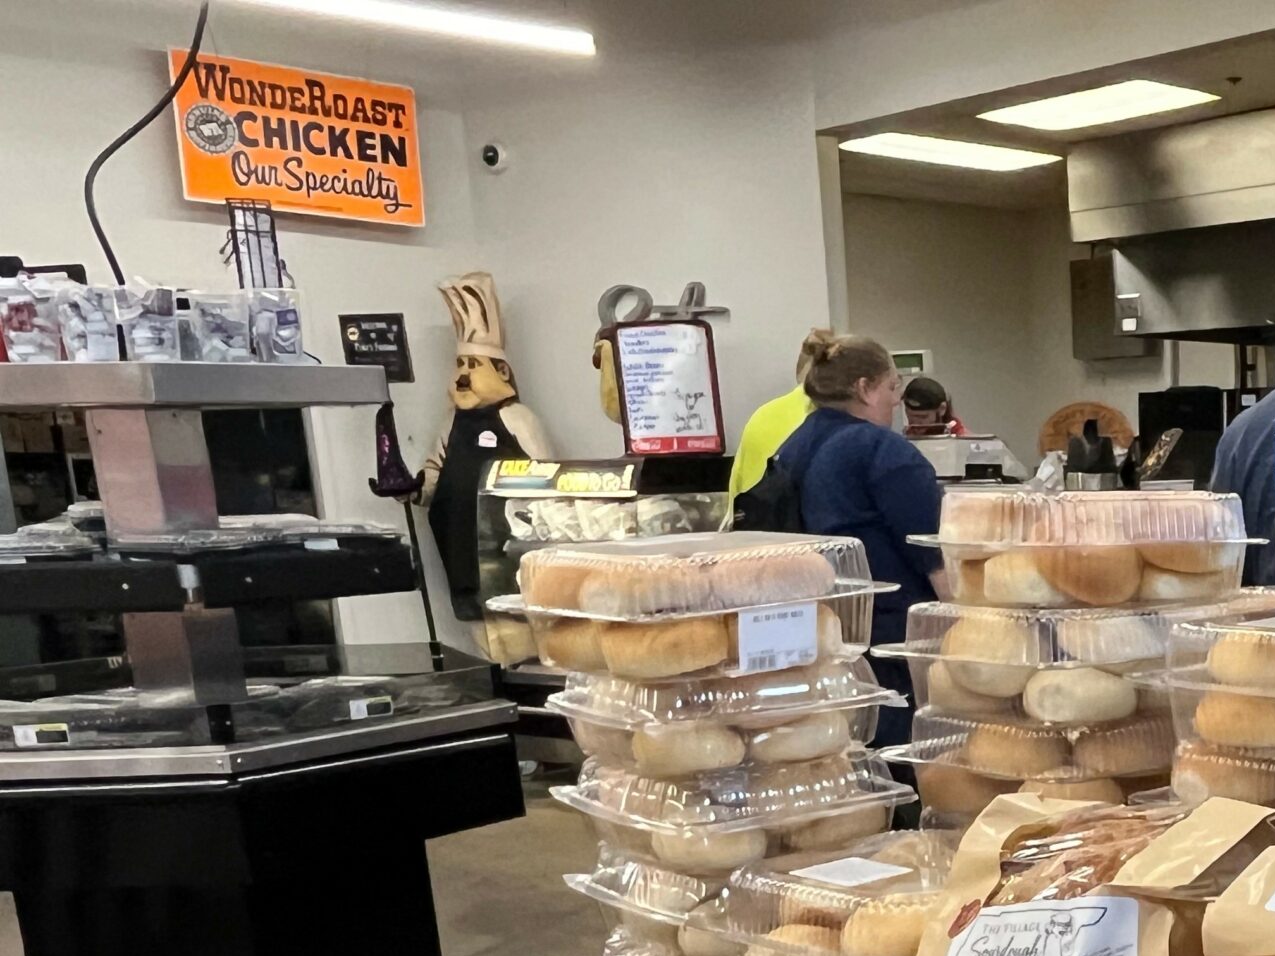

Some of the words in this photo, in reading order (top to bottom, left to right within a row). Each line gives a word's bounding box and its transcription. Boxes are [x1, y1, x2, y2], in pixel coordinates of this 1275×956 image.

[234, 110, 407, 168] CHICKEN
[231, 150, 282, 187] Our
[283, 156, 413, 214] Specialty
